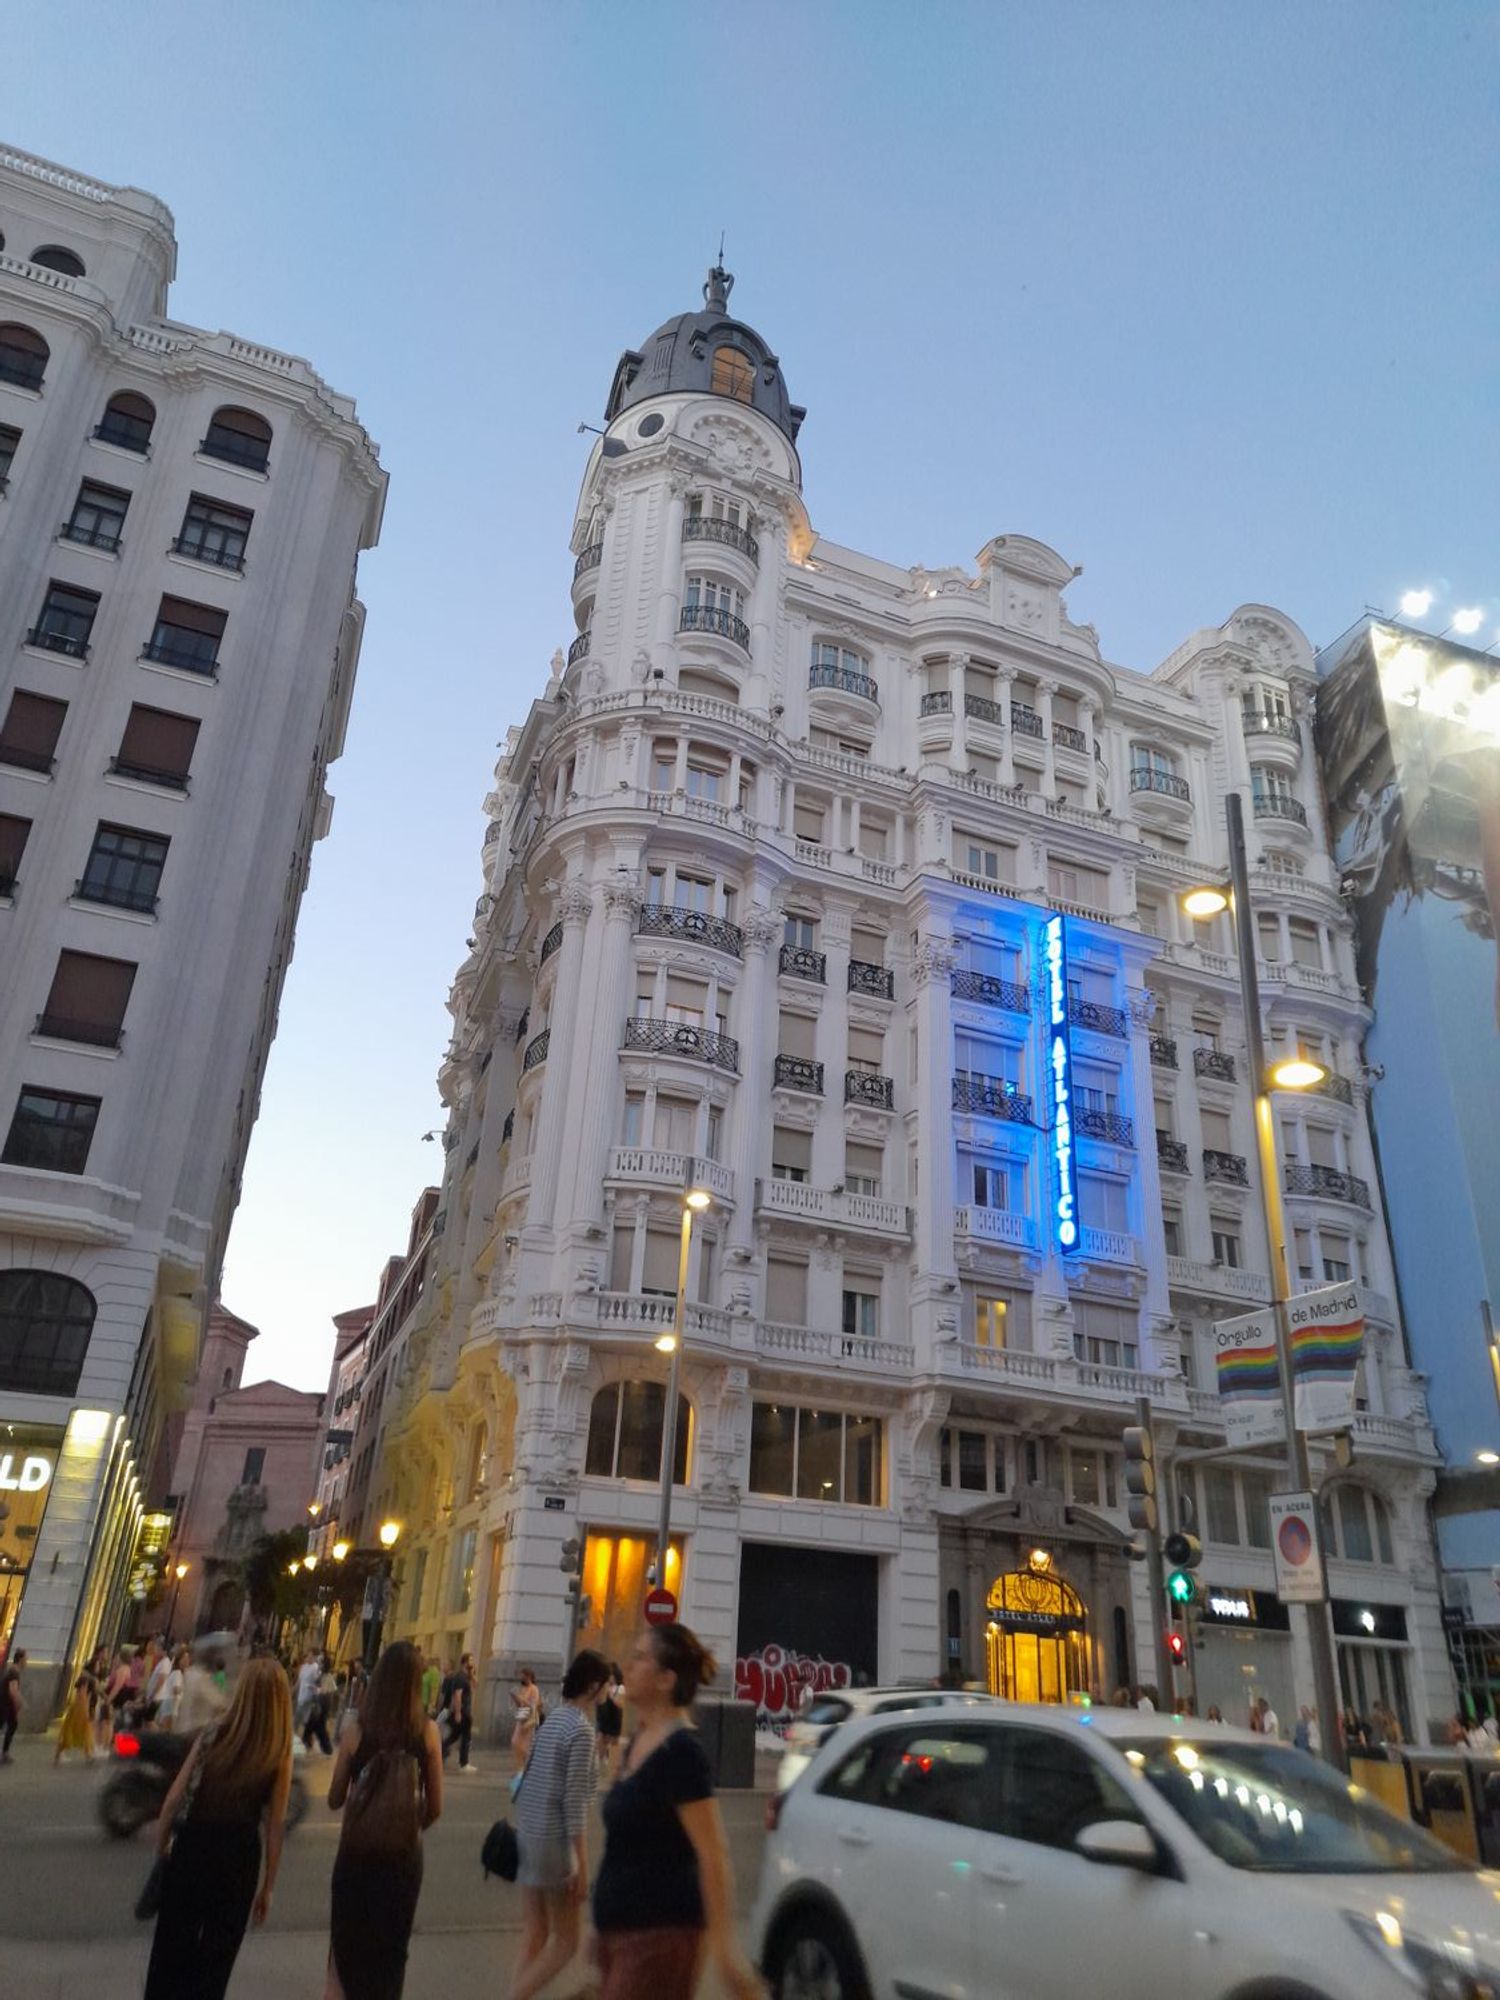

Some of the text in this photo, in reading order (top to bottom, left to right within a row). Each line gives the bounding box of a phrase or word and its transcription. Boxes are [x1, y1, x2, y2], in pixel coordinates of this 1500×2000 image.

[1047, 916, 1076, 1246] HOTEL ATLANTICO
[1291, 1294, 1358, 1324] de Madrid
[1217, 1326, 1262, 1347] Orgullo
[1272, 1502, 1311, 1514] EN ACERA
